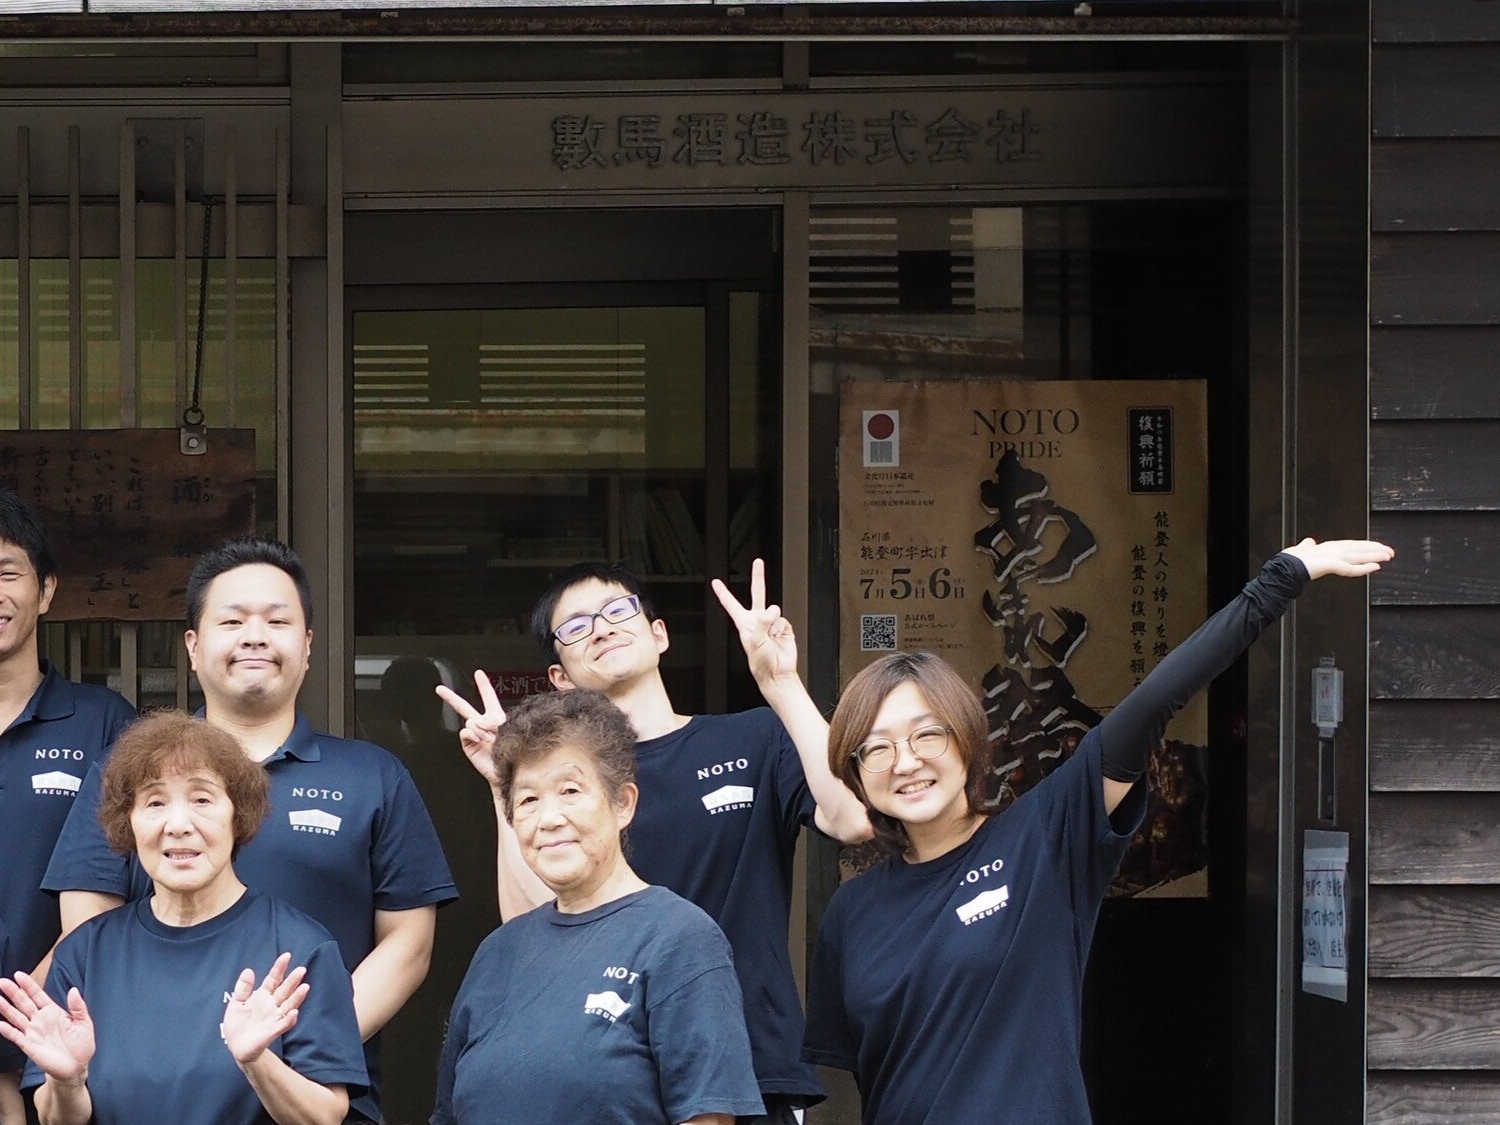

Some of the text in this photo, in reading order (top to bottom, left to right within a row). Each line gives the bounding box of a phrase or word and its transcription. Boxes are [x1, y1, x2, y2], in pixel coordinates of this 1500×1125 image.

[971, 407, 1080, 436] NOTO
[988, 440, 1063, 458] PRIDE
[1136, 414, 1156, 487] 復興祈願
[1152, 511, 1170, 665] 能登人の誇りを燈
[34, 748, 84, 761] NOTO
[696, 757, 749, 781] NOTO
[35, 788, 76, 797] KAZUMA
[291, 787, 344, 801] NOTO
[709, 802, 753, 816] KAZUMA
[292, 825, 337, 836] KAZUMA
[959, 858, 1004, 886] OTO
[964, 901, 1008, 927] KAZUMA
[602, 966, 640, 985] NOT
[584, 1008, 617, 1024] KAZUM
